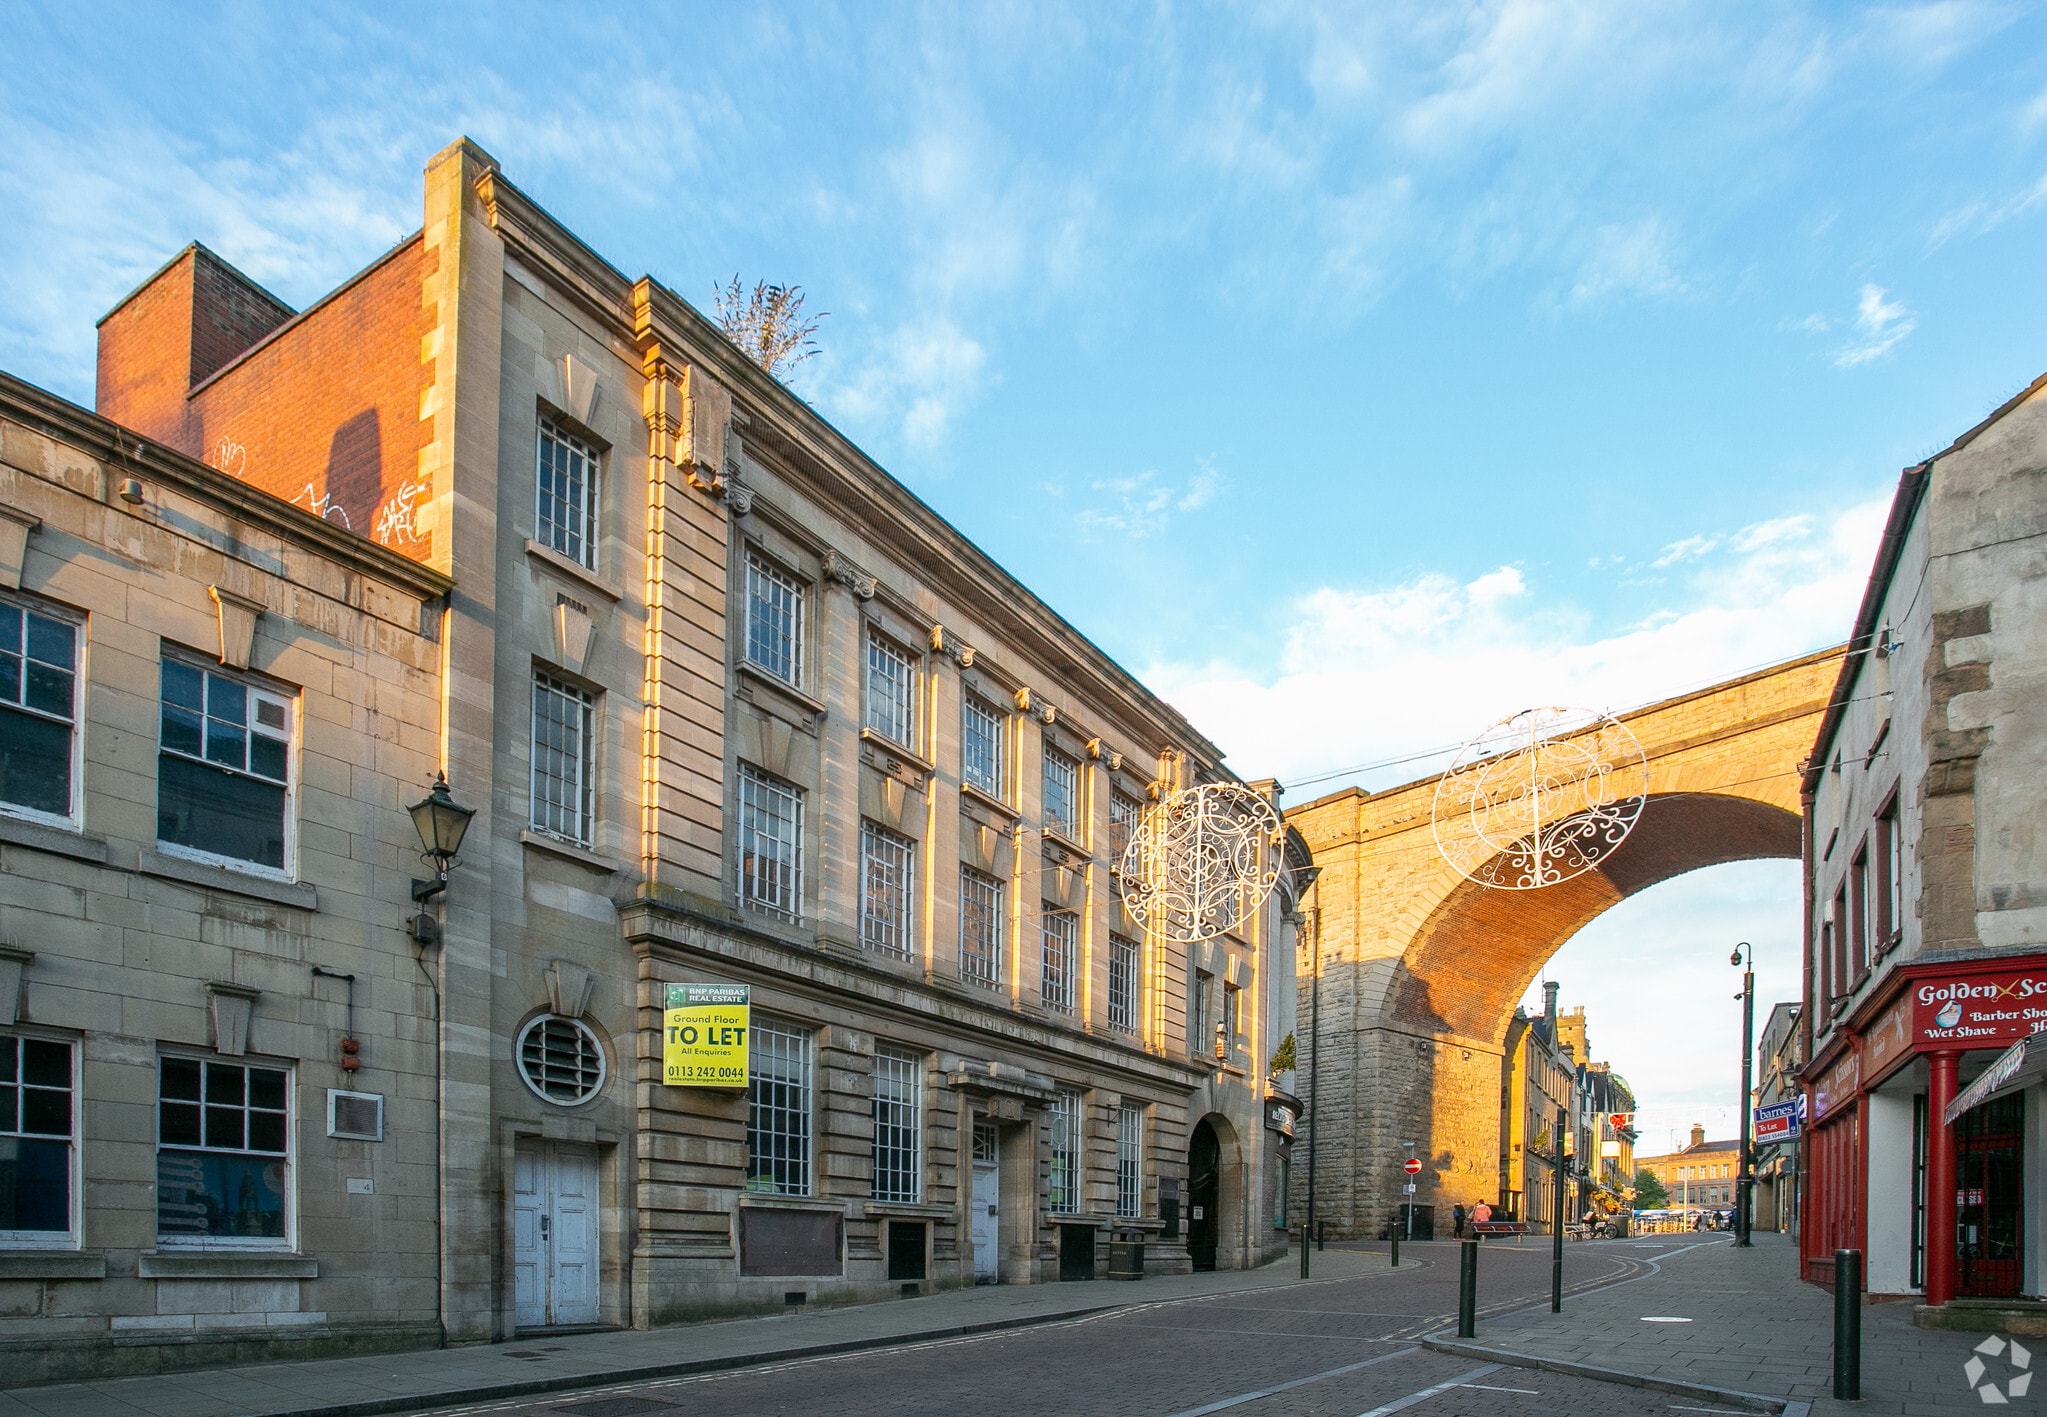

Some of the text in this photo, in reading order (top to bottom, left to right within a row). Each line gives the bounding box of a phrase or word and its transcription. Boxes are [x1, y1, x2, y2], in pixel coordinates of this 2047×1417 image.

[1918, 983, 1997, 1006] Golden
[673, 1014, 739, 1024] Ground Floor
[1970, 1011, 2019, 1021] Barber
[666, 1026, 746, 1046] TO LET
[1924, 1029, 1954, 1038] Wet
[1956, 1027, 1996, 1037] Shave
[695, 1048, 731, 1056] Enquiries
[668, 1066, 744, 1078] 0113 242 0044
[1759, 1105, 1793, 1120] barnes
[1758, 1123, 1778, 1132] To Let
